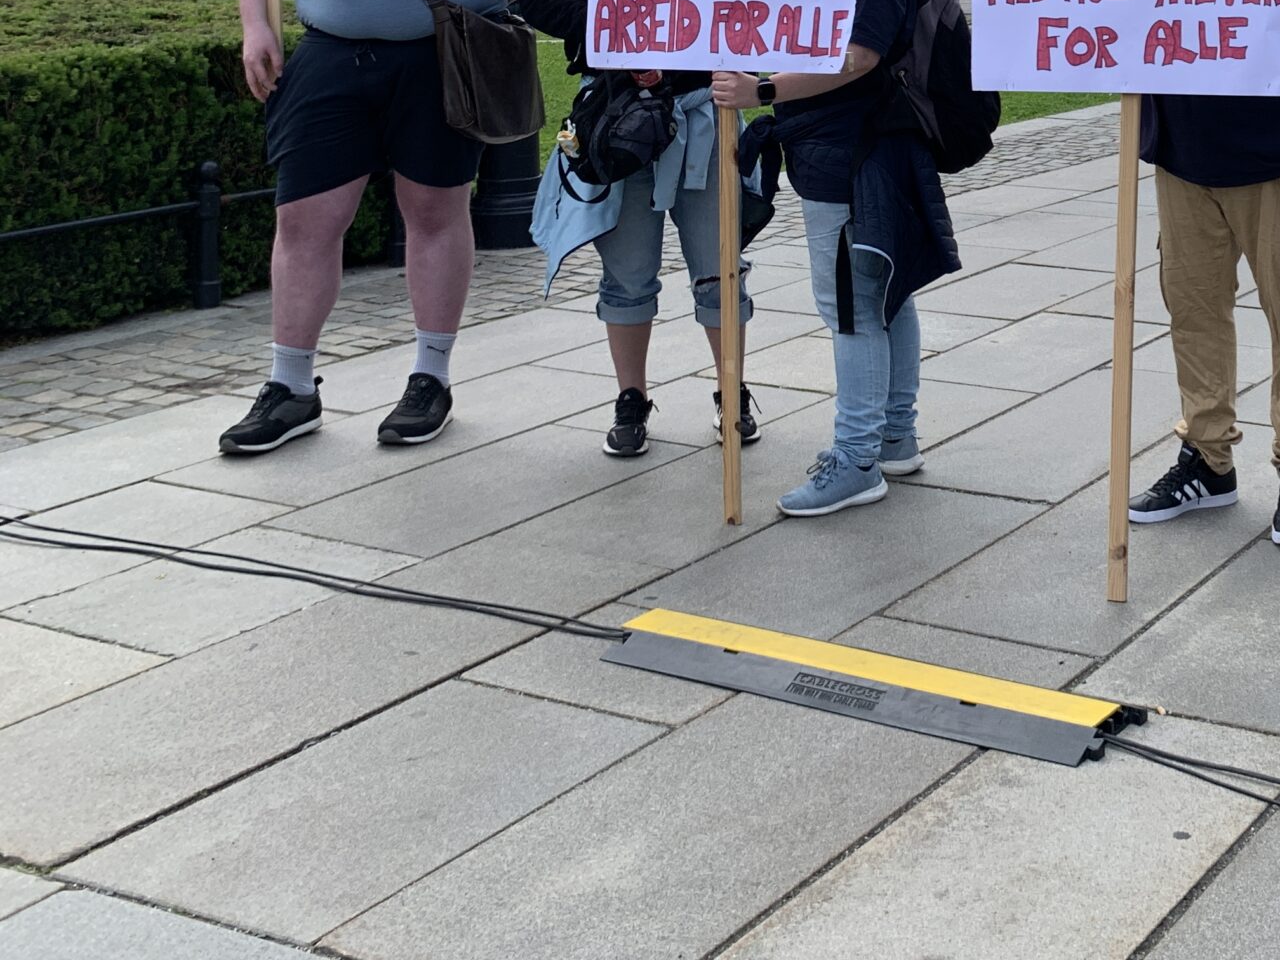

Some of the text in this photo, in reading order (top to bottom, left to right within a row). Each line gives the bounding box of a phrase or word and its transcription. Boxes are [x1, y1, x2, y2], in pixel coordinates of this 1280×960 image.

[710, 0, 769, 56] FOR
[773, 4, 849, 57] ALLE
[1036, 17, 1249, 71] FOR ALLE
[799, 674, 882, 700] CABLECROSS
